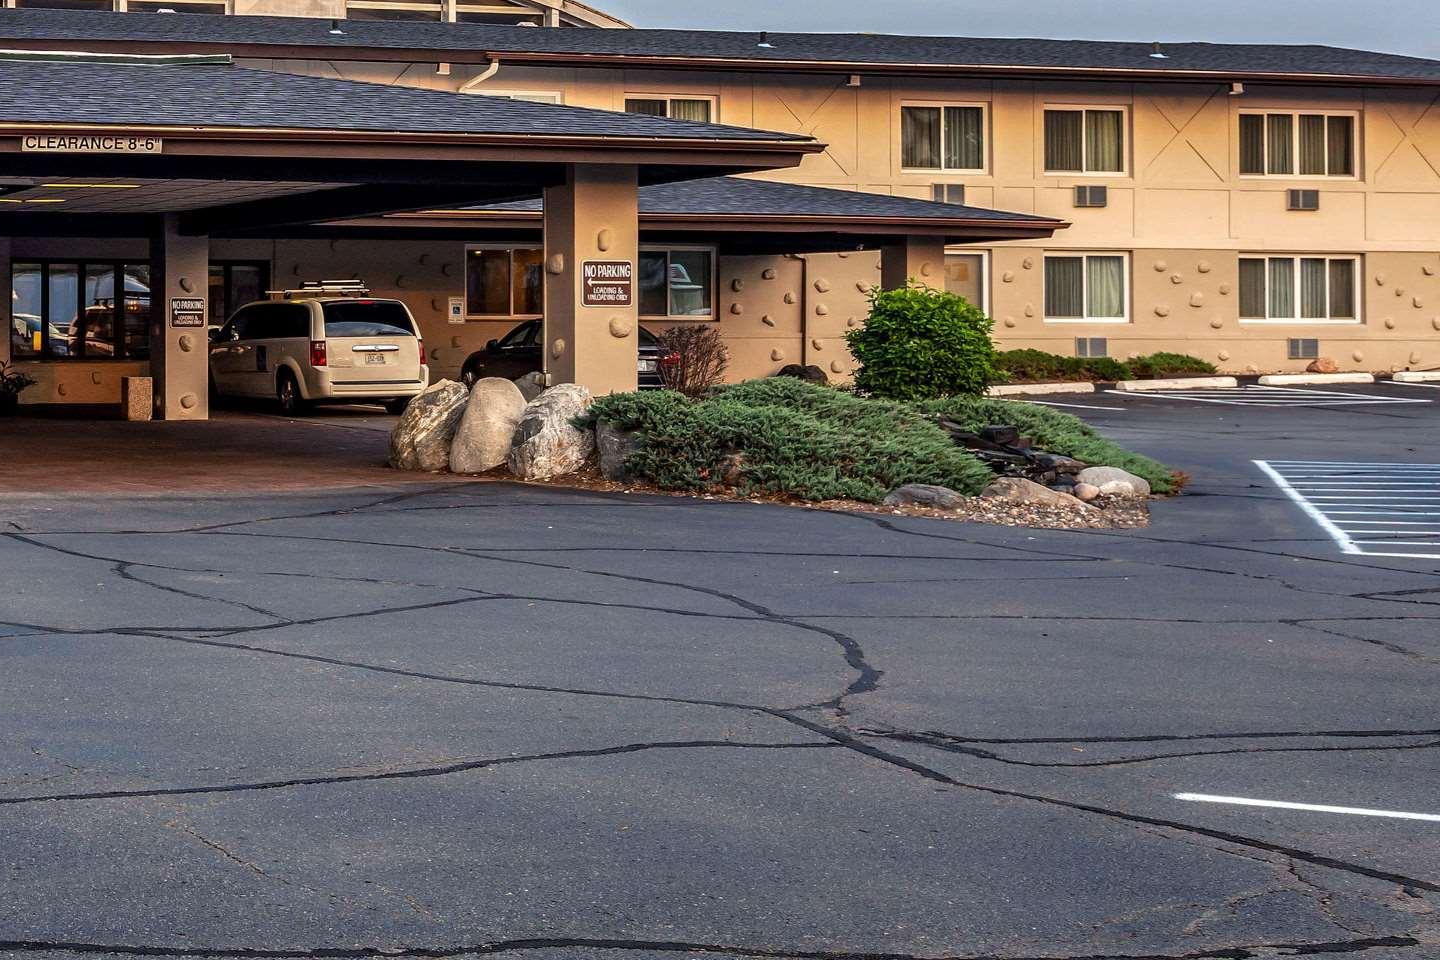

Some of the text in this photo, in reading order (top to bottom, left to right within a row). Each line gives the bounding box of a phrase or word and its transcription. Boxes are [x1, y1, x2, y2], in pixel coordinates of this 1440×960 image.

[25, 136, 124, 150] CLEARANCE
[585, 265, 630, 277] NO PARKING
[172, 300, 203, 309] NO PARKING
